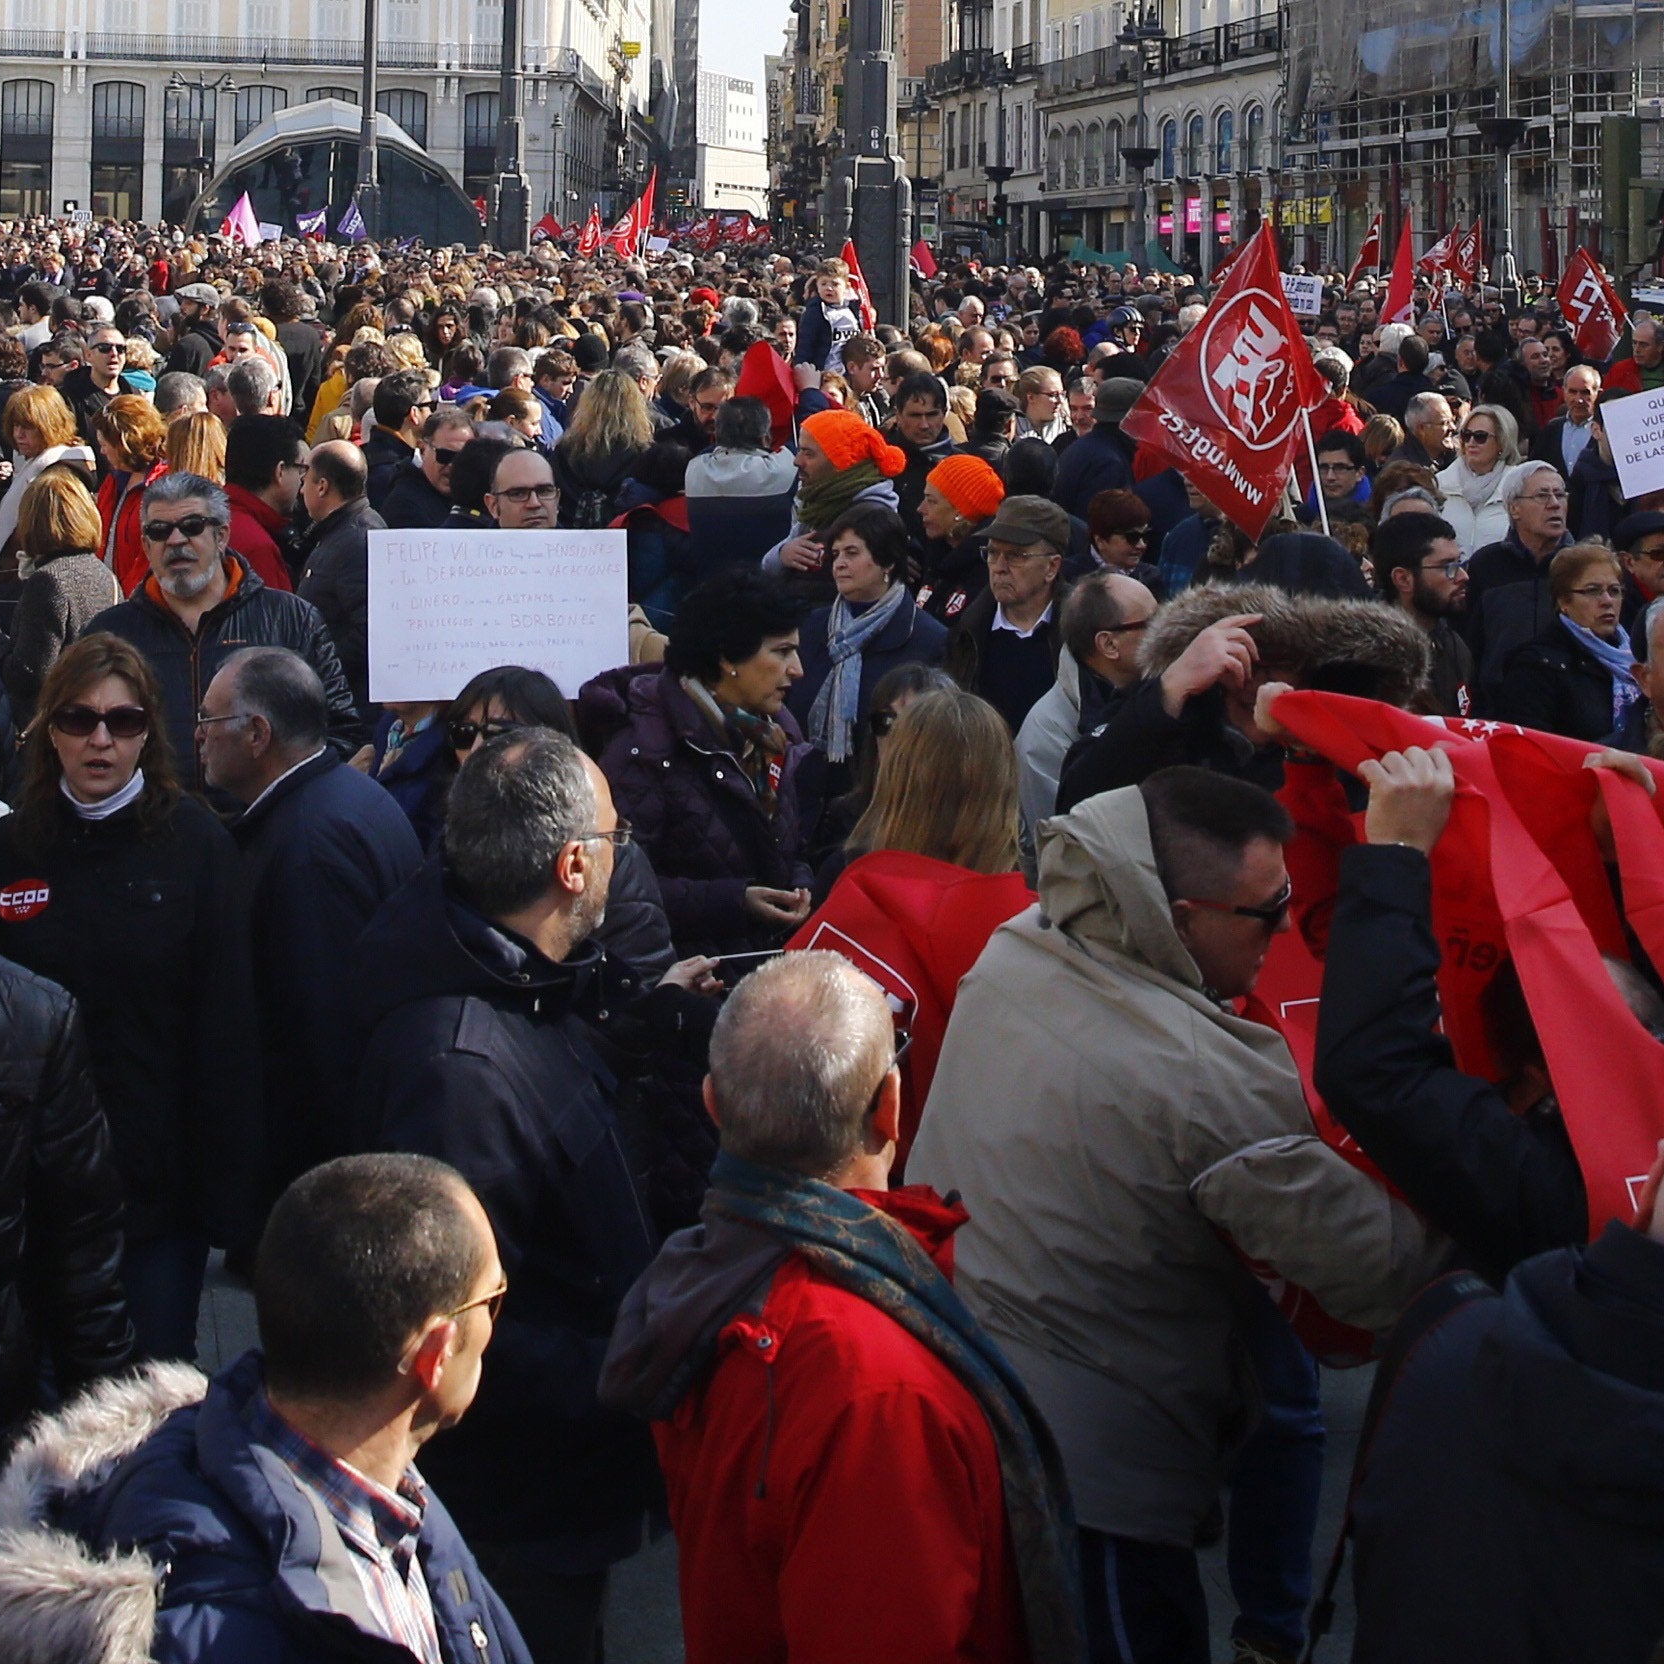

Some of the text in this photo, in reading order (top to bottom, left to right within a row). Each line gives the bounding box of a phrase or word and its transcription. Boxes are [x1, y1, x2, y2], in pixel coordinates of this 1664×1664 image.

[1625, 452, 1642, 465] DE
[386, 542, 439, 563] FELIPE
[450, 542, 467, 560] VI
[510, 613, 597, 629] BORBONES
[0, 887, 50, 907] CCOO
